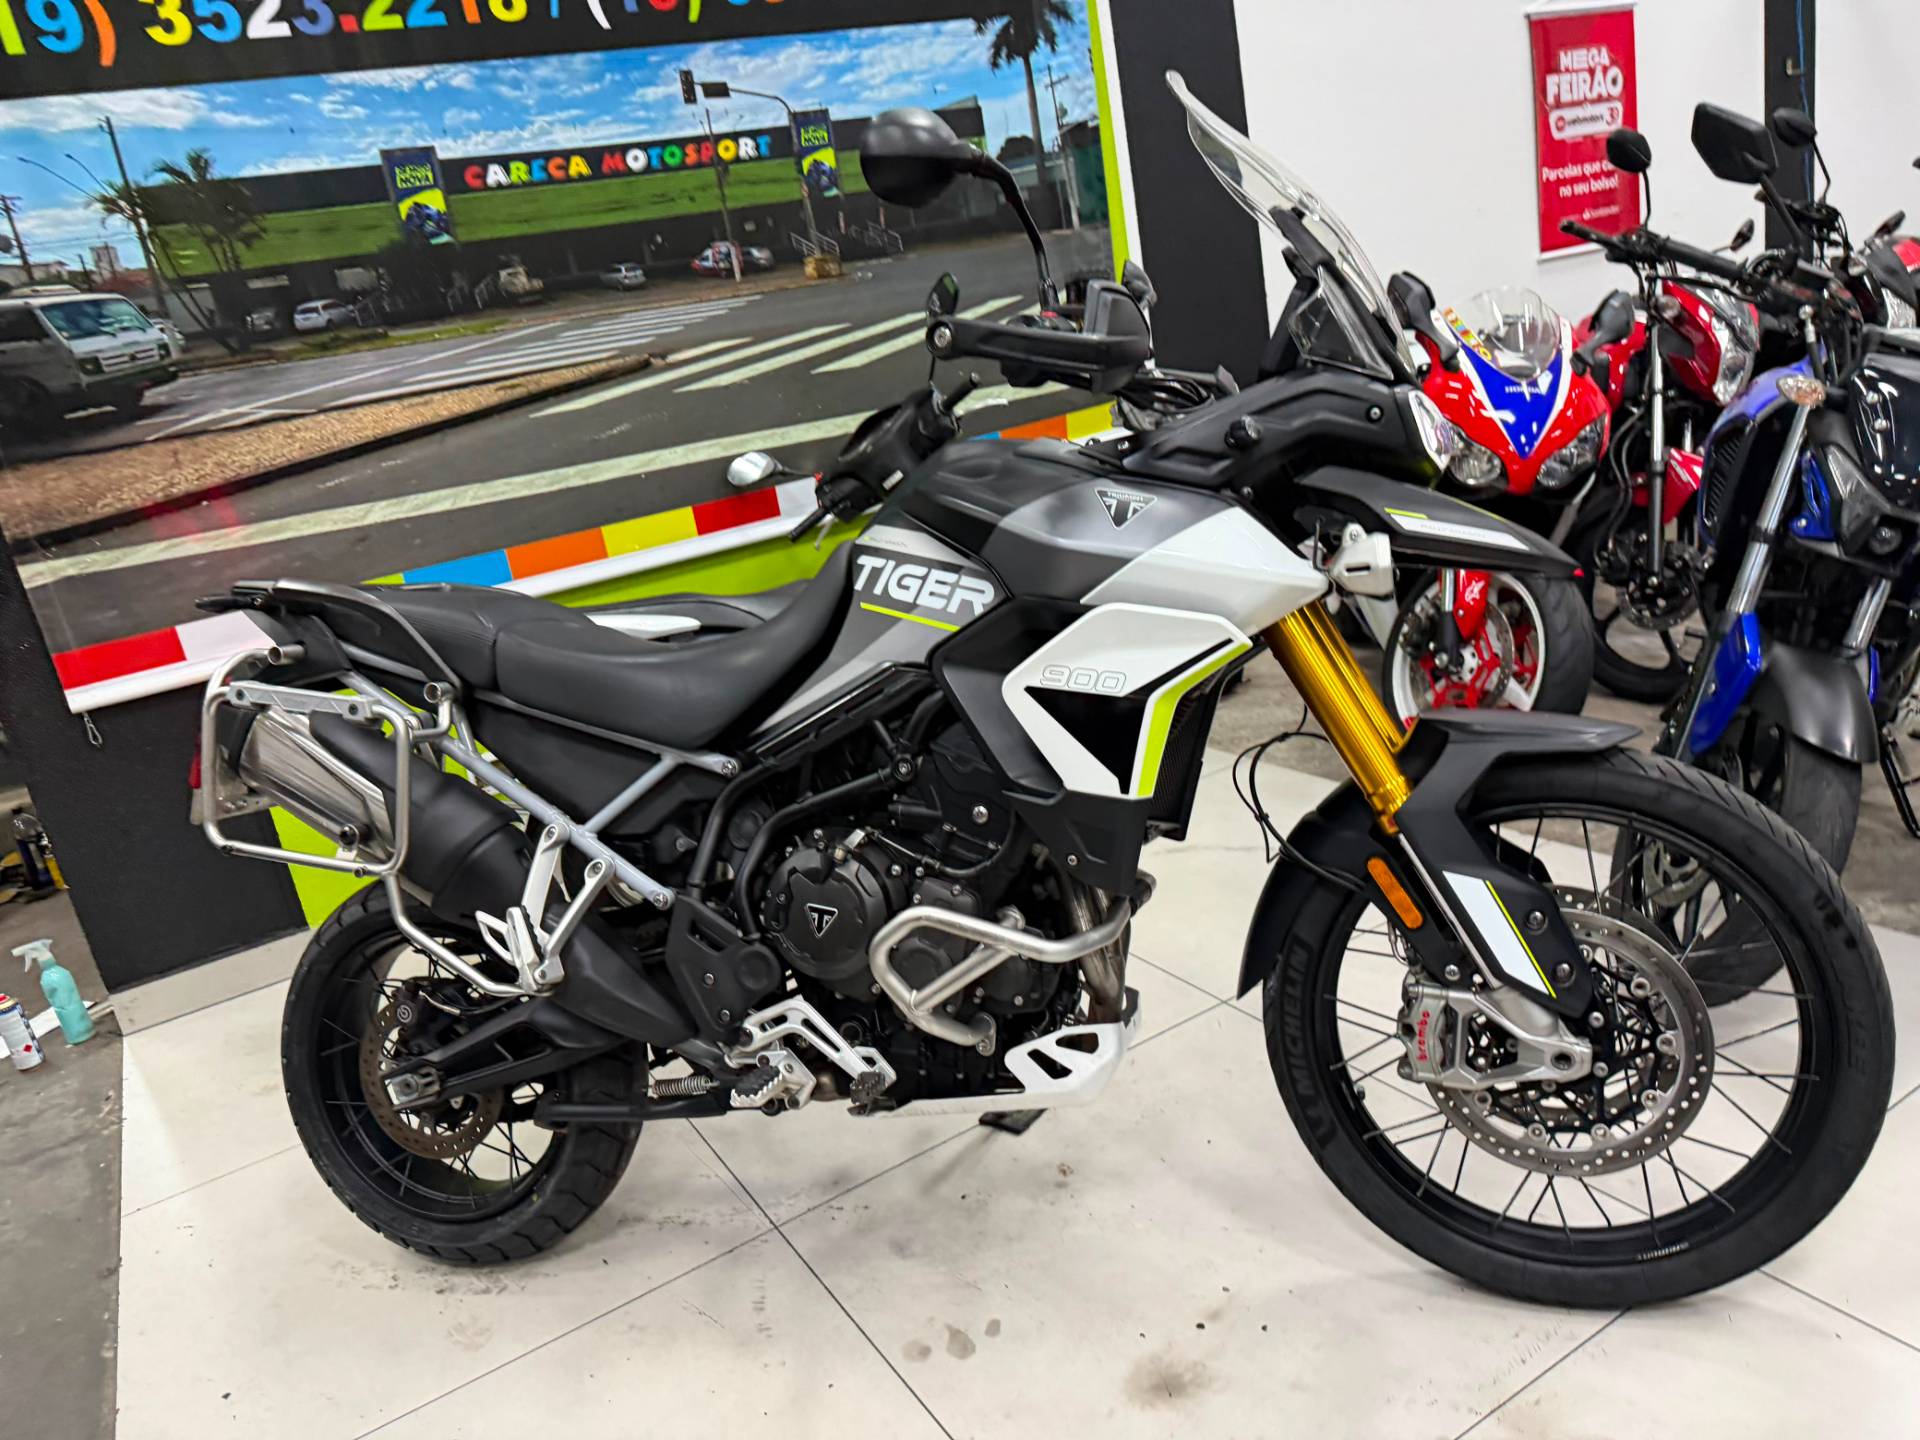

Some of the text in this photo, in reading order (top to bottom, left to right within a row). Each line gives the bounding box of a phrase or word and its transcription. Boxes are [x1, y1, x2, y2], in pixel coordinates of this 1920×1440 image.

[464, 135, 772, 190] CARECA MOTOSPORT
[1559, 184, 1573, 198] no
[854, 554, 995, 616] TIGER
[1040, 664, 1127, 693] 900
